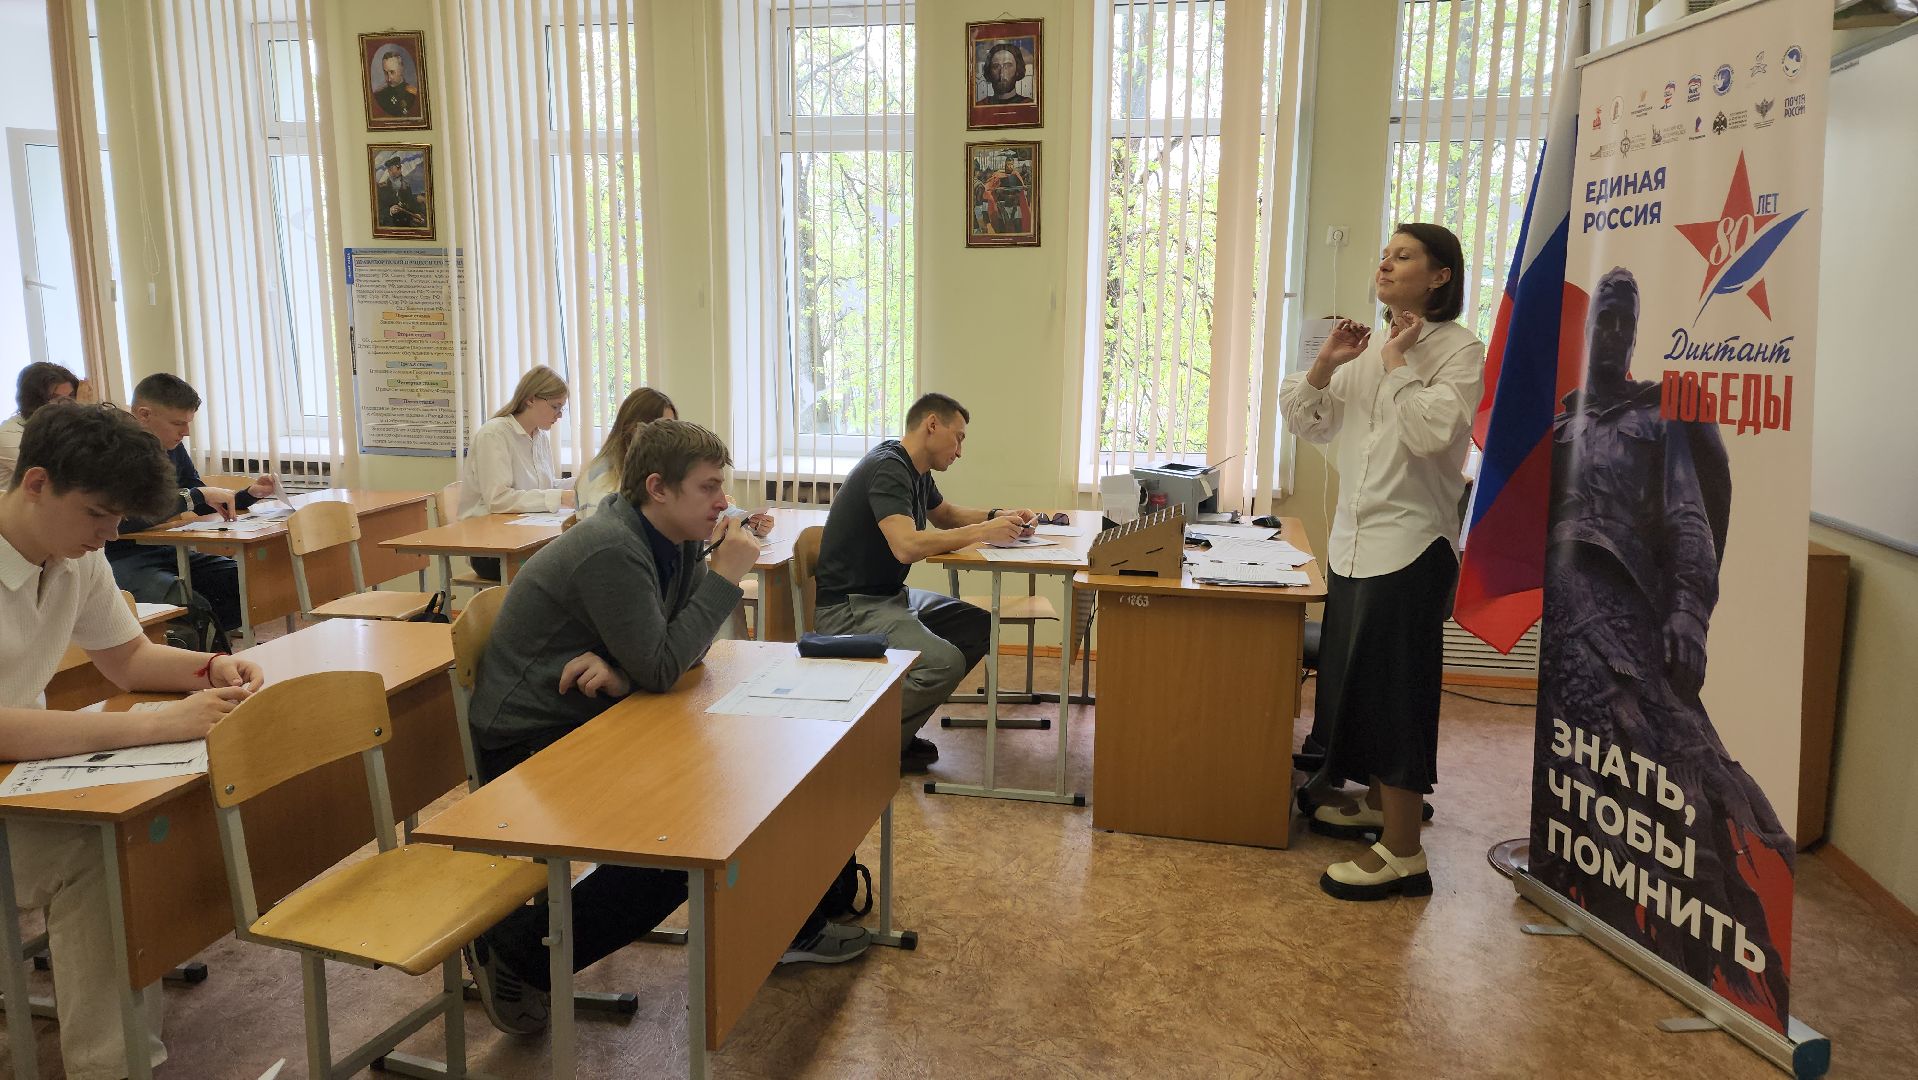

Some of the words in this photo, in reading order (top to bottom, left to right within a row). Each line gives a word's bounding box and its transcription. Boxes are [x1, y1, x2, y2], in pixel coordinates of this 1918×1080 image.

[1585, 166, 1667, 205] ЕДИНАЯ
[1757, 192, 1780, 215] ЛЕТ
[1583, 201, 1662, 234] РОССИЯ
[1709, 213, 1755, 266] 80
[1663, 327, 1795, 364] Диктант
[1659, 369, 1794, 436] ПОБЕДЫ
[1551, 718, 1697, 828] ЗНАТЬ,
[1548, 766, 1696, 880] ЧТОБЫ
[1547, 817, 1766, 974] ПОМНИТЬ
